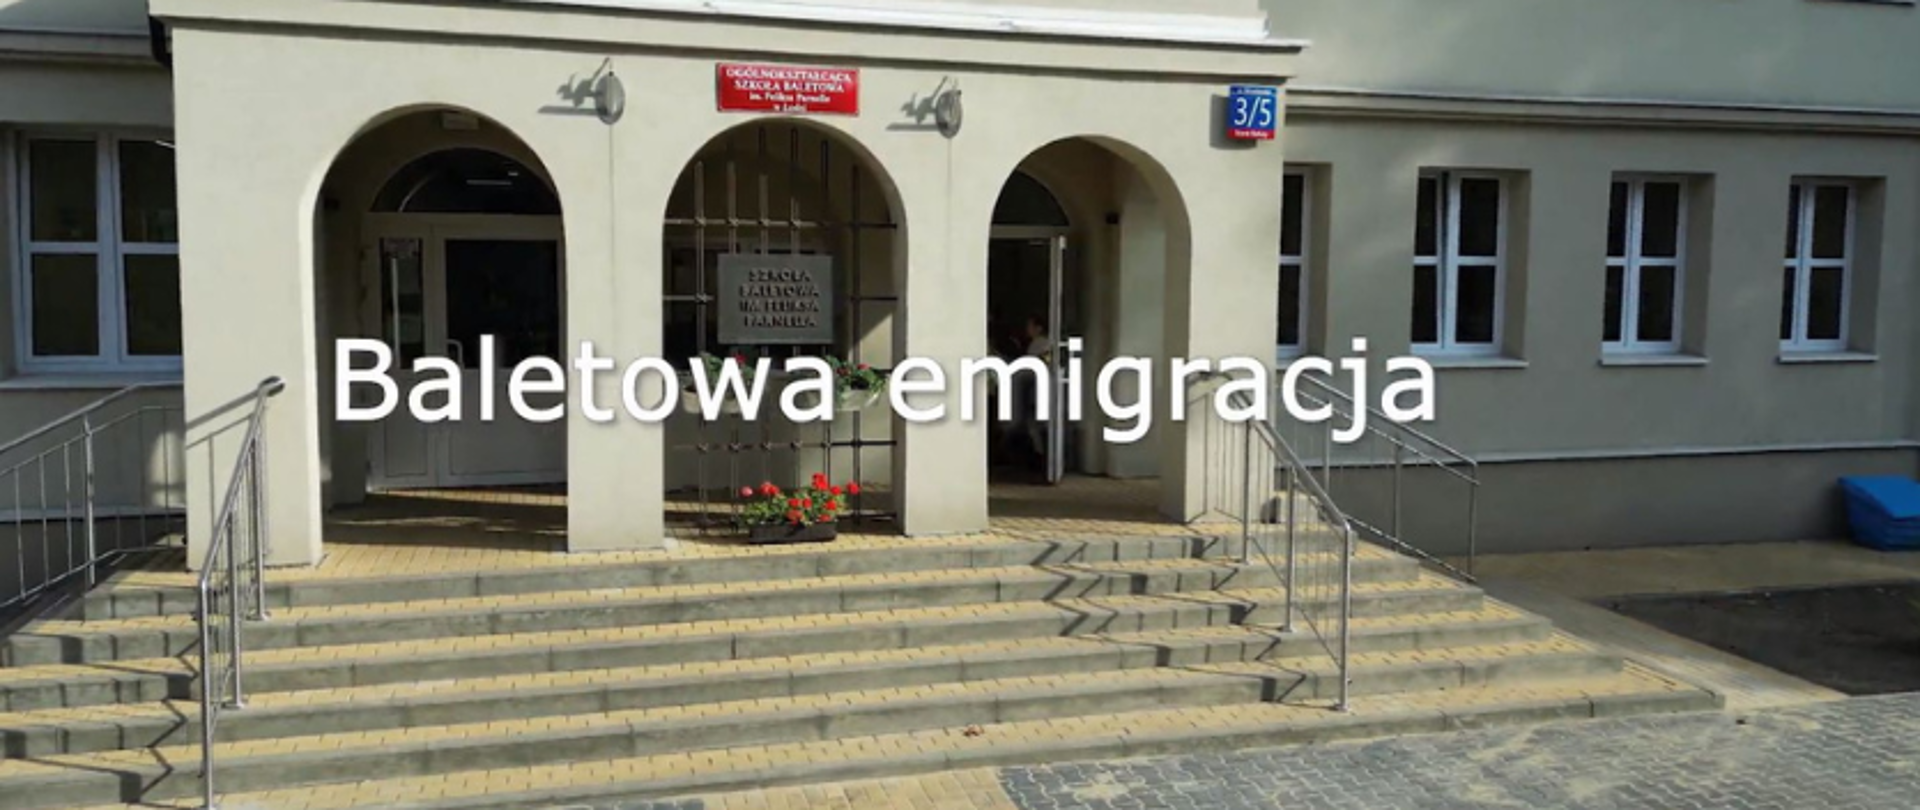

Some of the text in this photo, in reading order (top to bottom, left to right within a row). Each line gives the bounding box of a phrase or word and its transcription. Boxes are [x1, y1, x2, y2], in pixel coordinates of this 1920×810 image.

[784, 80, 844, 93] BALETOWA
[1234, 96, 1272, 127] 3/5
[739, 283, 819, 297] BALETOWA
[744, 314, 817, 328] PARNELLA
